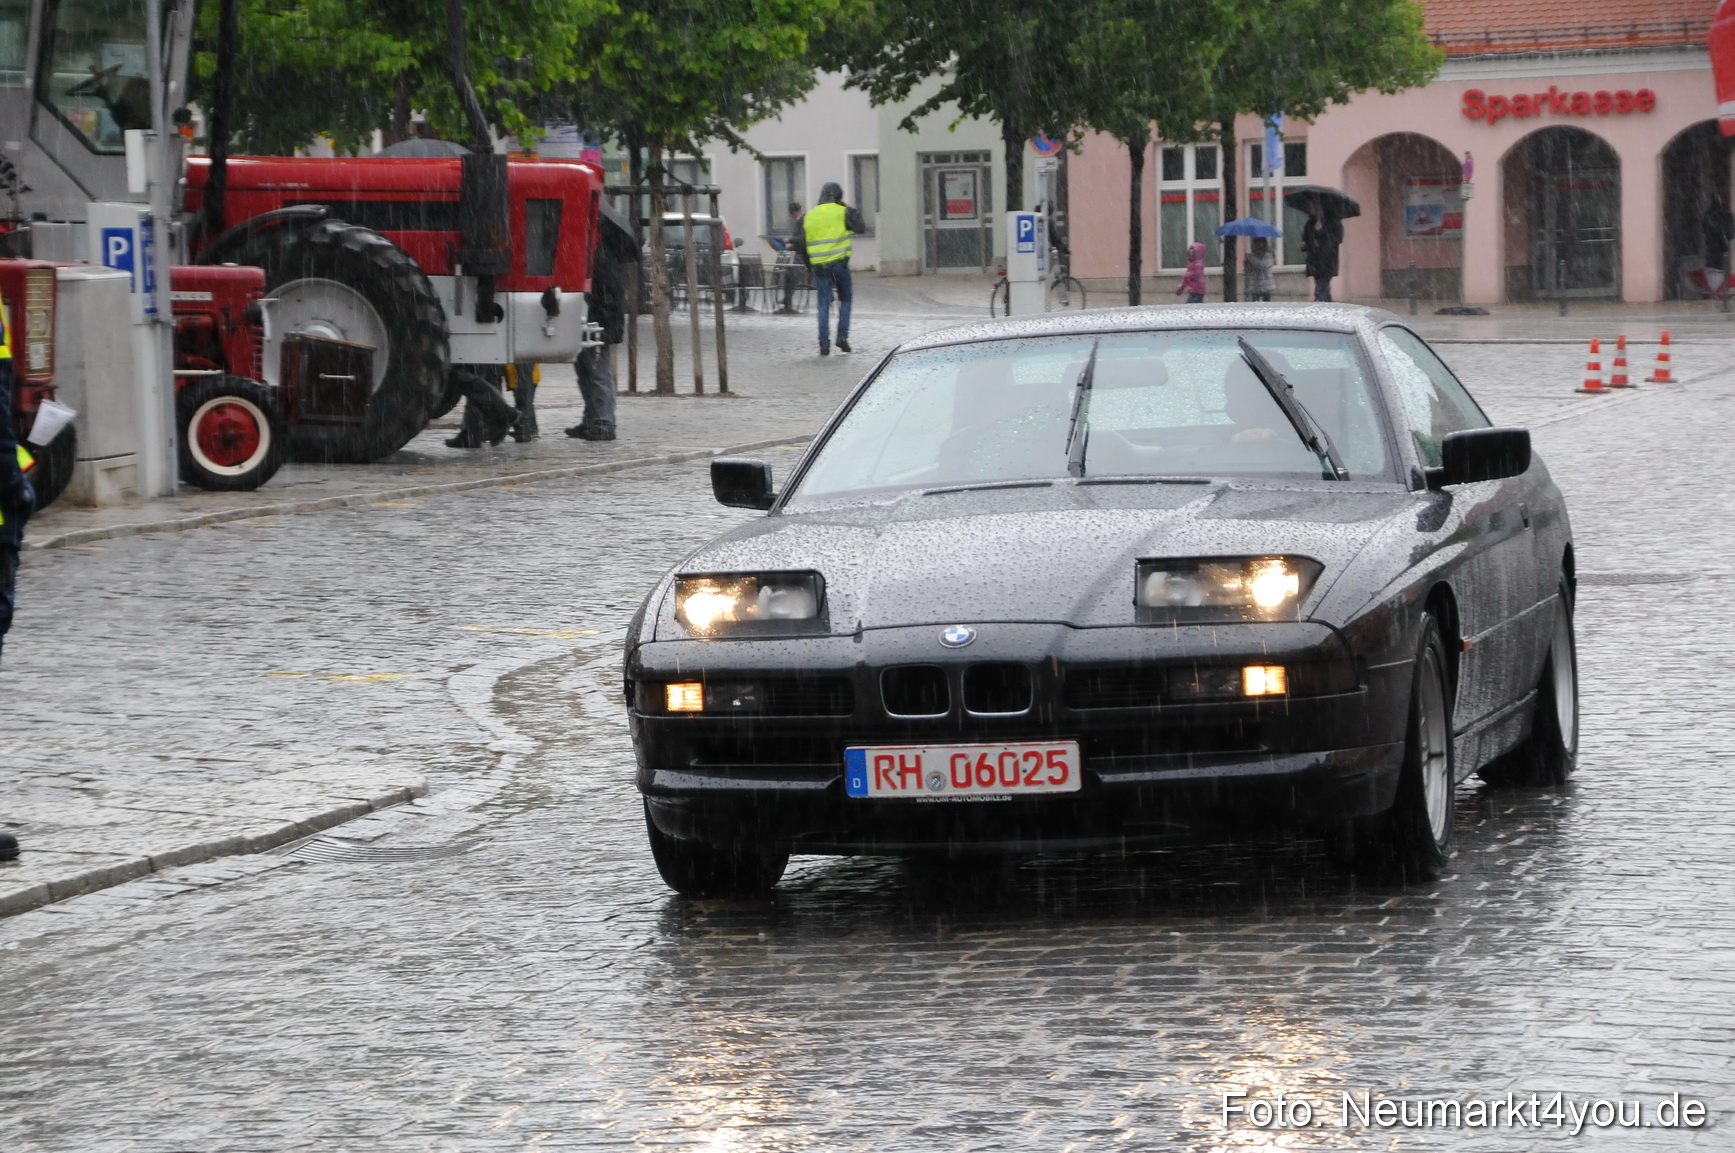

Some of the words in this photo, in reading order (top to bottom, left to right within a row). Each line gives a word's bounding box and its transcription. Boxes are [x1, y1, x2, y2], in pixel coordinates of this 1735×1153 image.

[1462, 85, 1656, 124] Sparkasse
[1020, 219, 1032, 238] P
[108, 236, 128, 266] P
[852, 777, 861, 789] D
[874, 754, 924, 790] RH
[950, 750, 1070, 788] 06025
